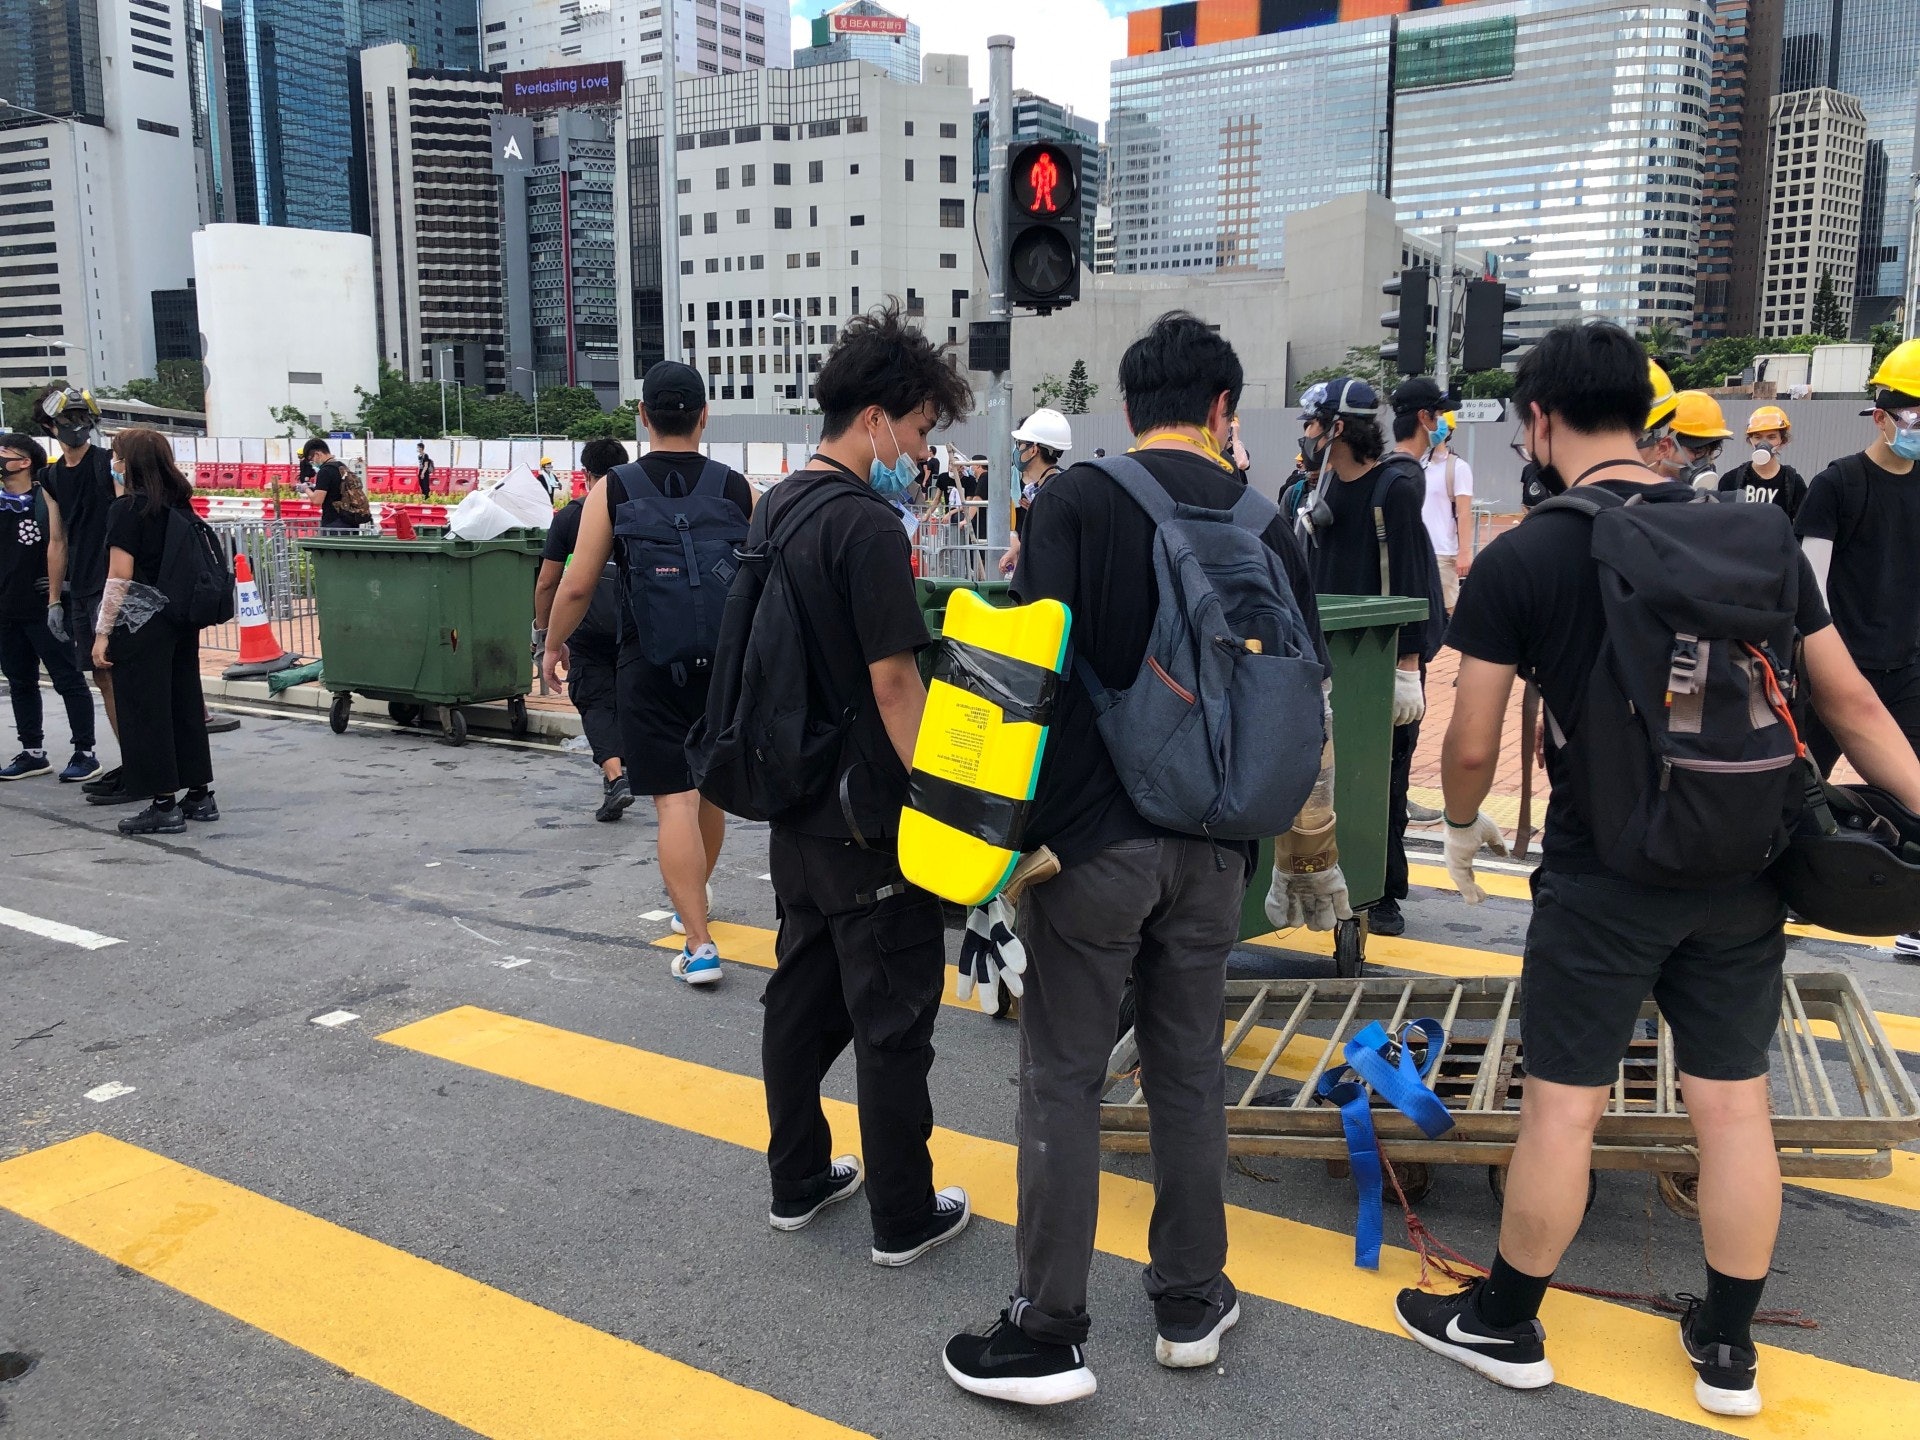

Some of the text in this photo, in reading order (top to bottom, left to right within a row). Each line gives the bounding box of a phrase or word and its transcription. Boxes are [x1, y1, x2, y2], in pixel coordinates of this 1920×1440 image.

[849, 19, 902, 30] BEA 東亞銀行
[515, 76, 609, 96] Everlasting Love
[1745, 484, 1779, 504] BOY
[240, 604, 265, 617] POLIC
